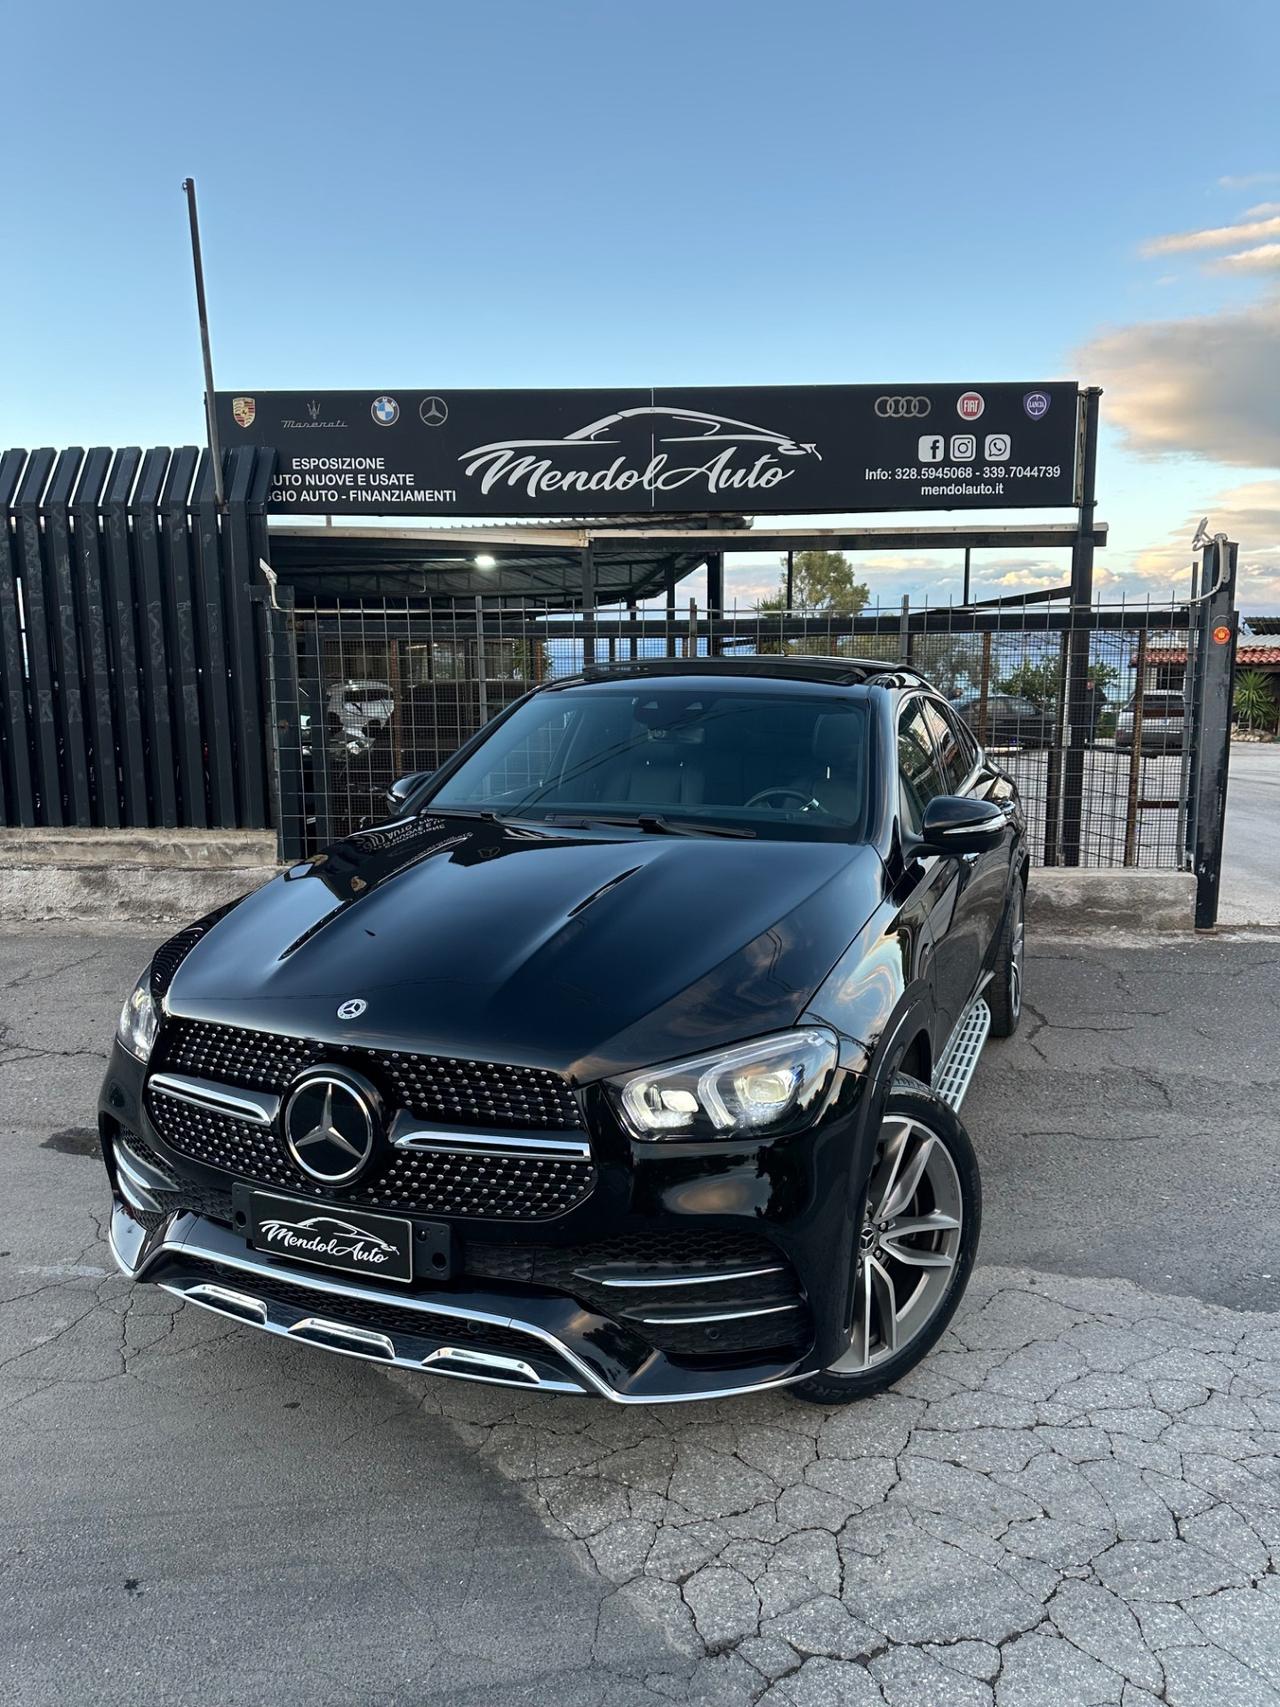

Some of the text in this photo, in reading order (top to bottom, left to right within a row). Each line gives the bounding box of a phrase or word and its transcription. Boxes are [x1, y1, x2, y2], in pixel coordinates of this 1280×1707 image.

[963, 399, 979, 412] FIAT
[292, 458, 385, 470] ESPOSIZIONE
[865, 467, 892, 480] Info:
[895, 466, 973, 479] 328.5945068
[983, 465, 1061, 478] 339.7044739
[271, 474, 415, 486] UTO NUOVE E USATE
[921, 483, 1004, 496] mendolauto.it
[300, 490, 338, 502] AUTO
[349, 490, 456, 502] FINANZIAMENTI
